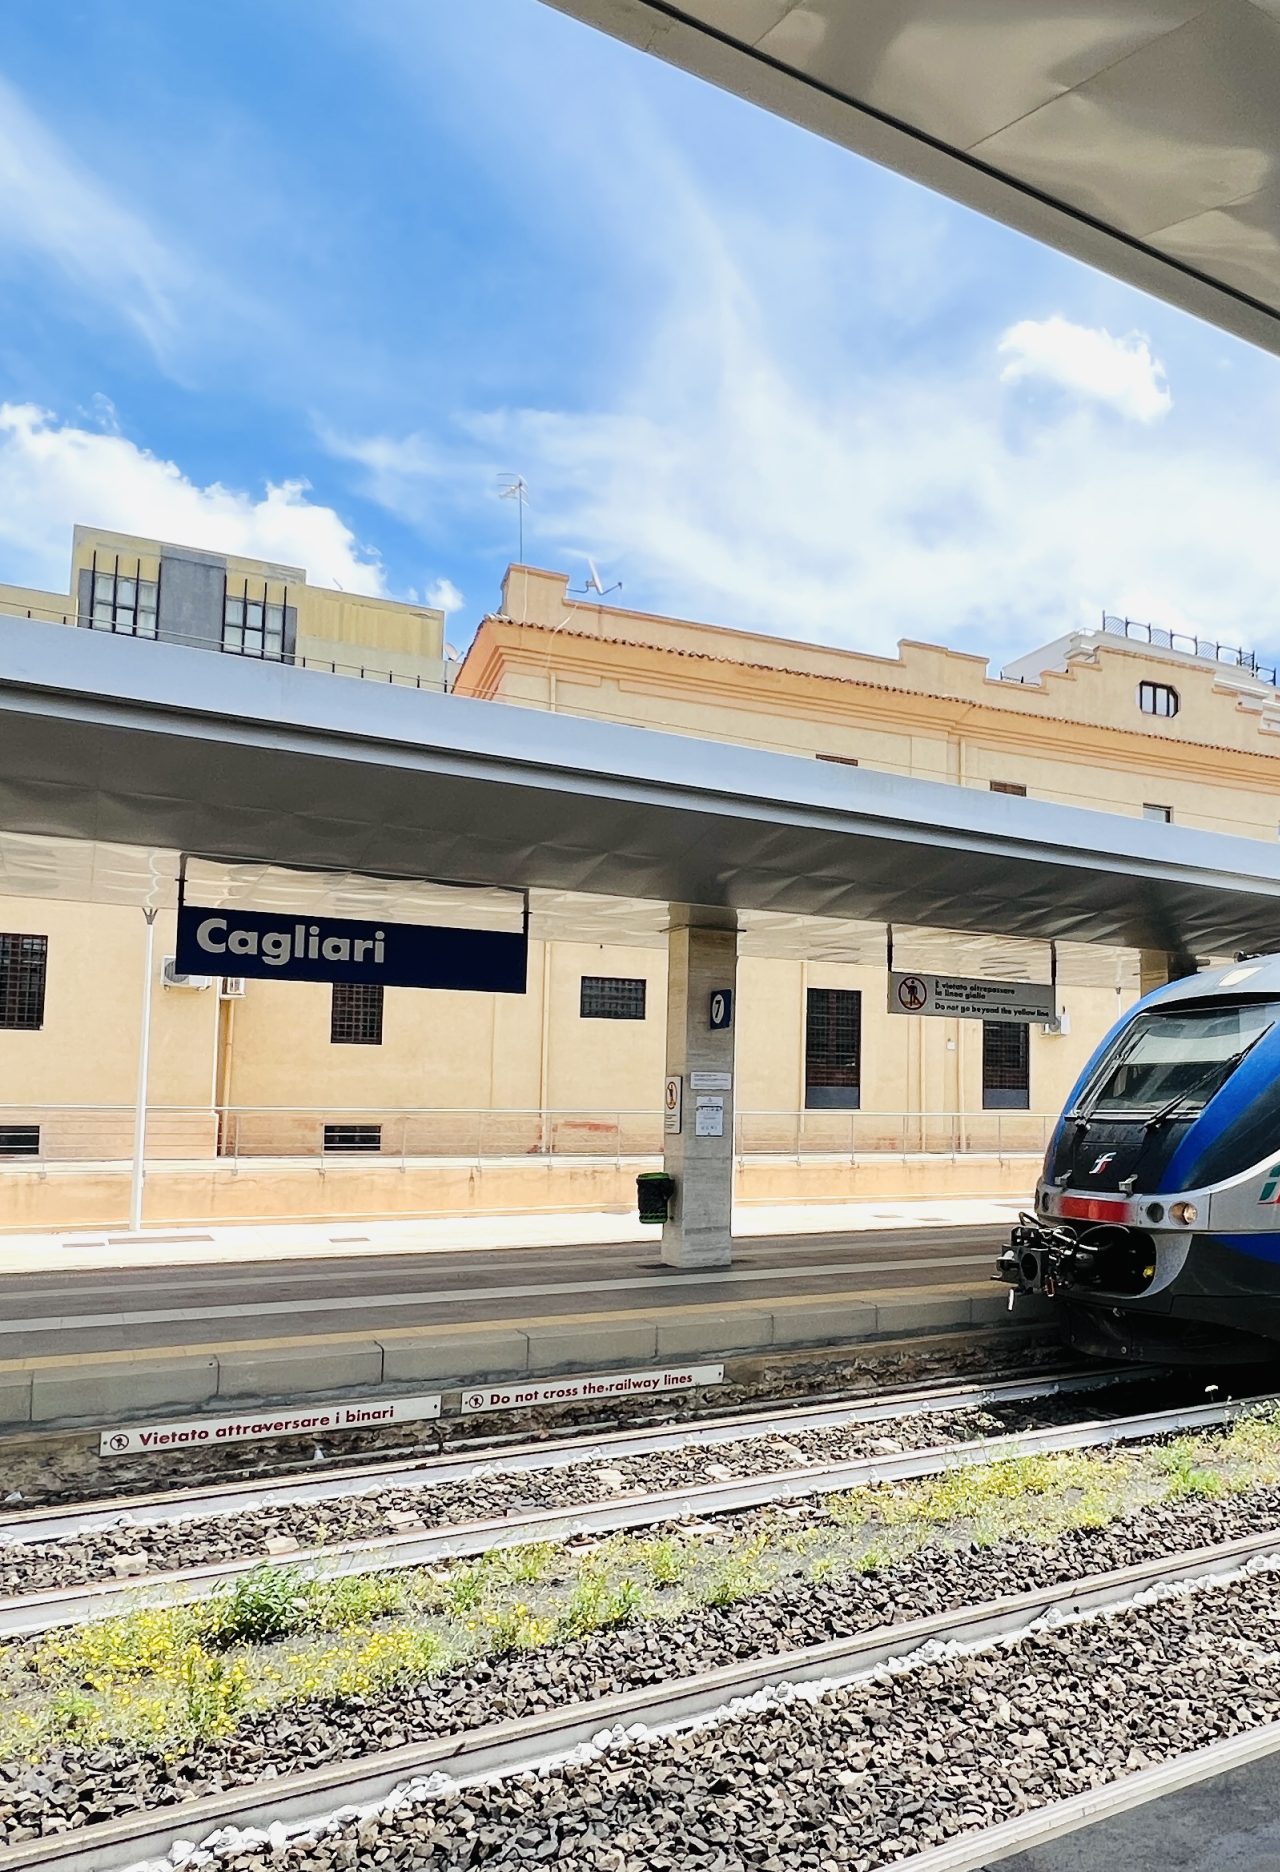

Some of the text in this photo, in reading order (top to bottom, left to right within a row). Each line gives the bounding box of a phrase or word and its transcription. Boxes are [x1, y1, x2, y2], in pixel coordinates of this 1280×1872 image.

[196, 917, 385, 966] Cagliari
[941, 982, 968, 991] vietato
[969, 984, 1015, 994] oltrepassare
[944, 989, 963, 997] linea
[965, 991, 986, 999] gialla
[714, 999, 722, 1019] 7
[935, 1002, 945, 1010] Do
[946, 1003, 959, 1011] not
[960, 1005, 970, 1013] go
[971, 1004, 999, 1014] beyond
[1000, 1007, 1012, 1015] the
[1013, 1008, 1036, 1016] yellow
[490, 1374, 693, 1405] Do not cross the railway lines
[139, 1405, 394, 1446] Vietato attraversare i binari
